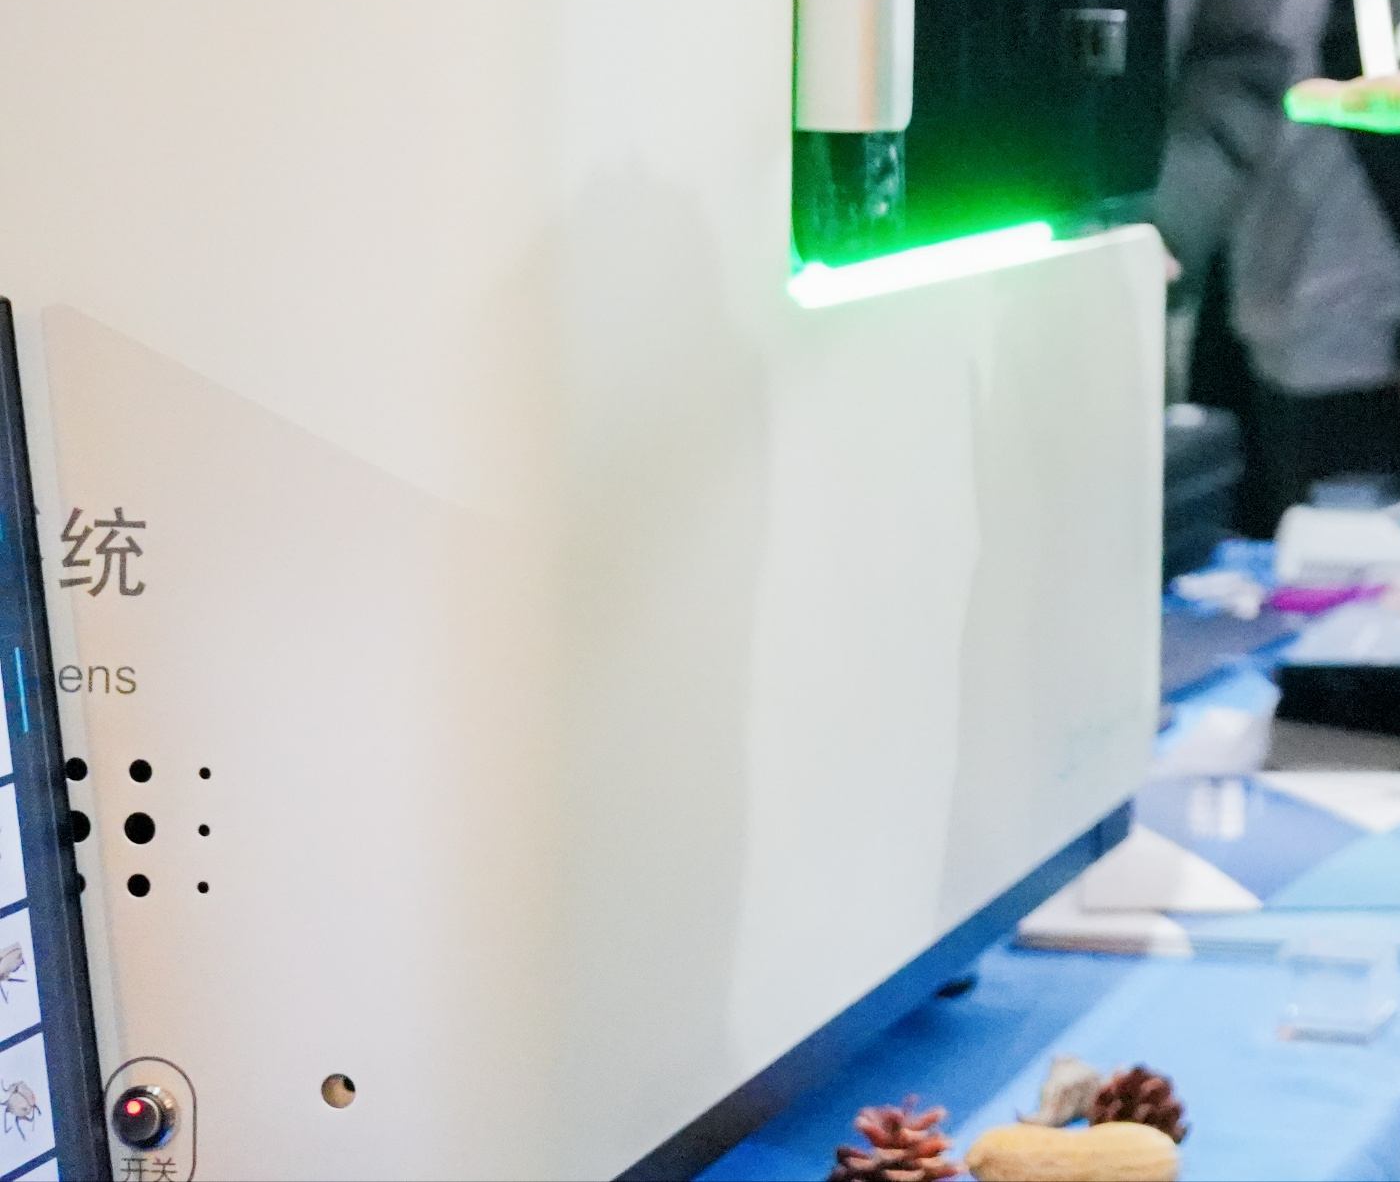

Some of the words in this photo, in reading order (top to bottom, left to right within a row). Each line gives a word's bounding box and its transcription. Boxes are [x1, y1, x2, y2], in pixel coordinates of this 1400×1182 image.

[36, 506, 146, 598] 统
[58, 664, 137, 695] ens
[120, 1157, 178, 1182] 开关
